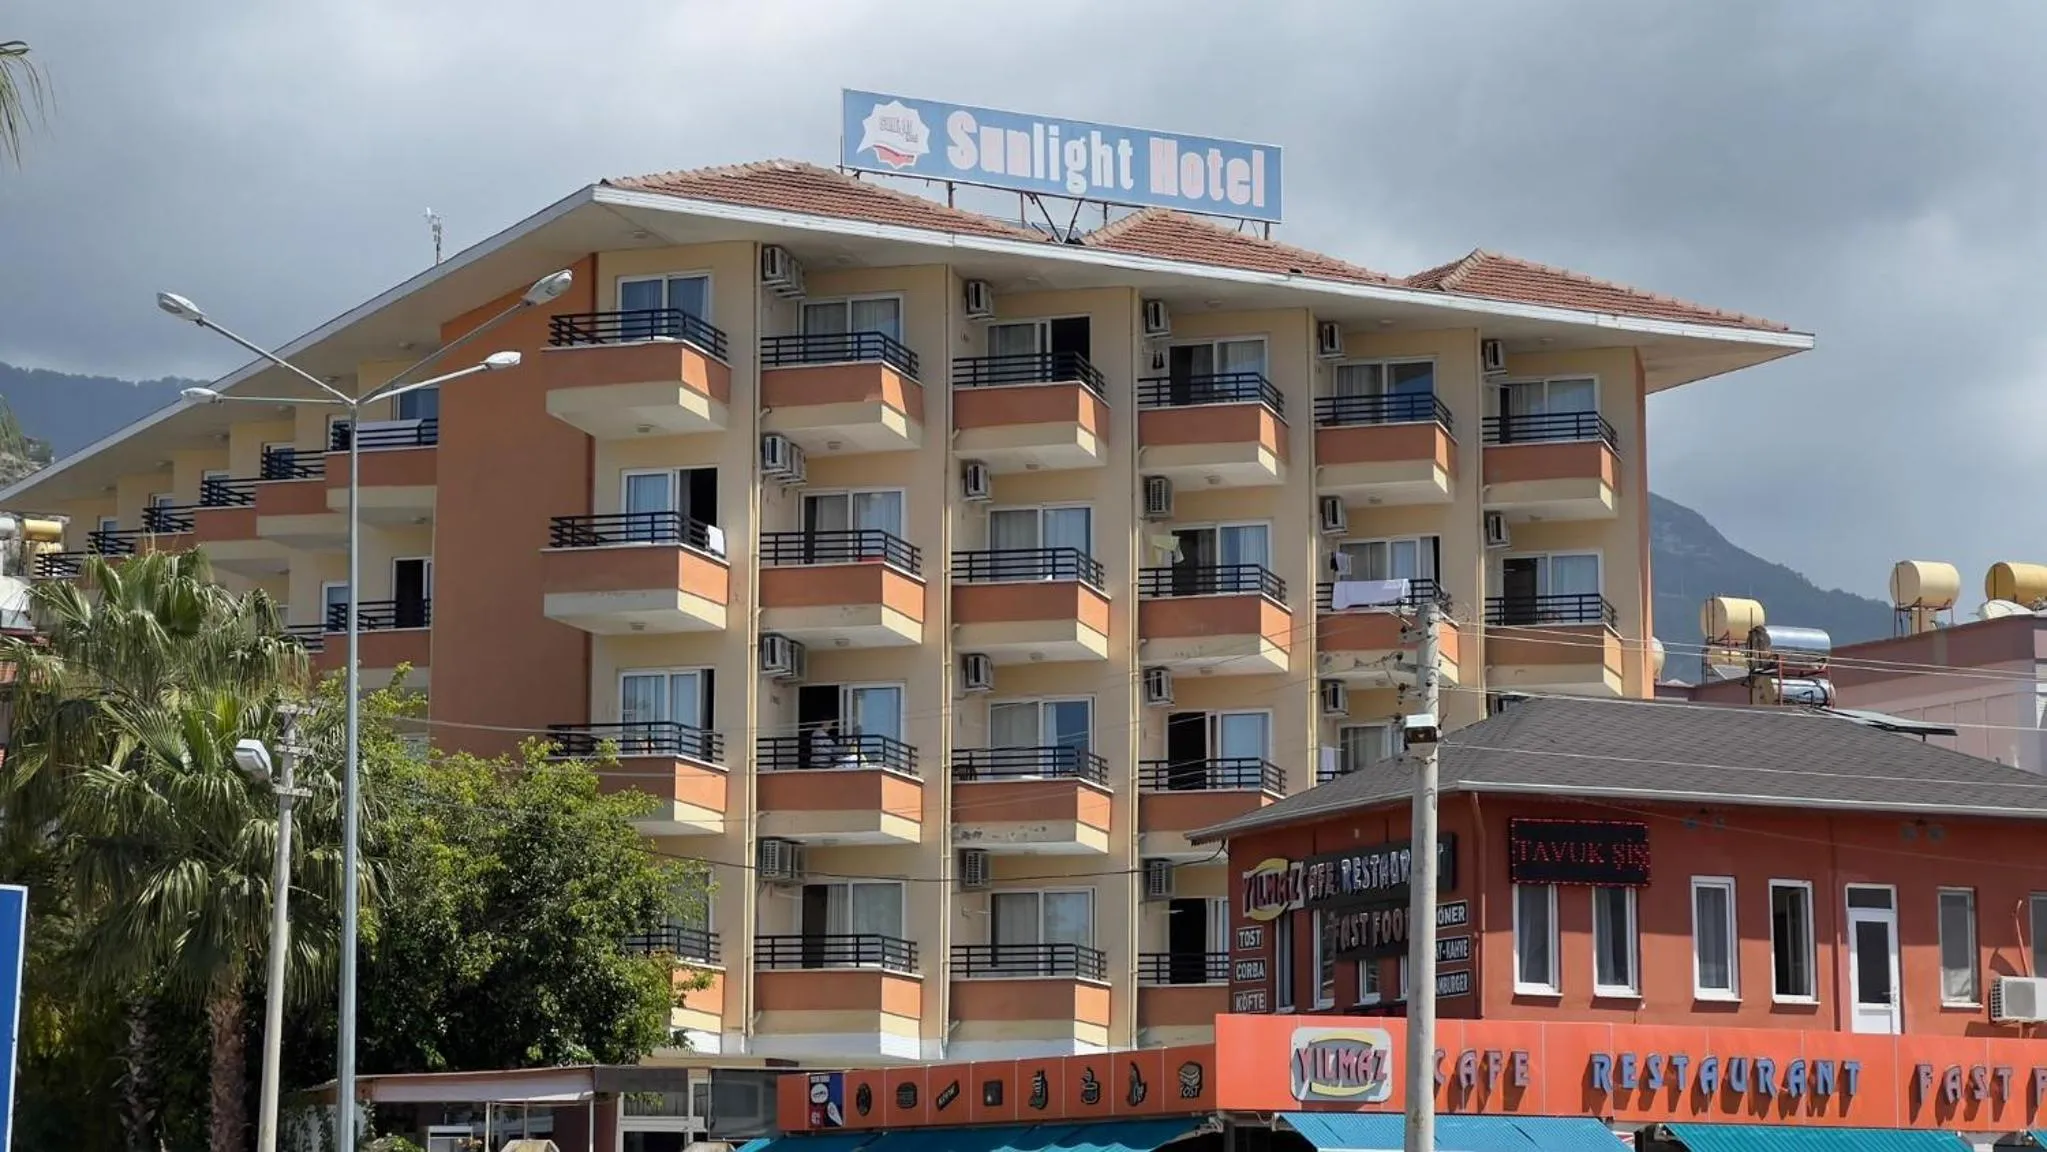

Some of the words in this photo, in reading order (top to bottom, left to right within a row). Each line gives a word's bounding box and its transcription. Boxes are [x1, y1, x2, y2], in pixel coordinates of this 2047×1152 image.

[946, 110, 1134, 195] Sunlight
[1149, 136, 1266, 208] Hotel
[1307, 863, 1337, 900] AFE
[1341, 843, 1444, 895] RESTAURT
[1515, 840, 1605, 863] TAVUK
[1243, 867, 1301, 913] YILMAZ
[1331, 911, 1369, 951] FAST
[1437, 905, 1466, 925] ÖNER
[1239, 929, 1262, 948] TOST
[1436, 973, 1468, 995] MBURGER
[1296, 1047, 1388, 1088] YILMAZ
[1590, 1054, 1861, 1097] RESTAURANT
[1915, 1063, 2014, 1108] FAST
